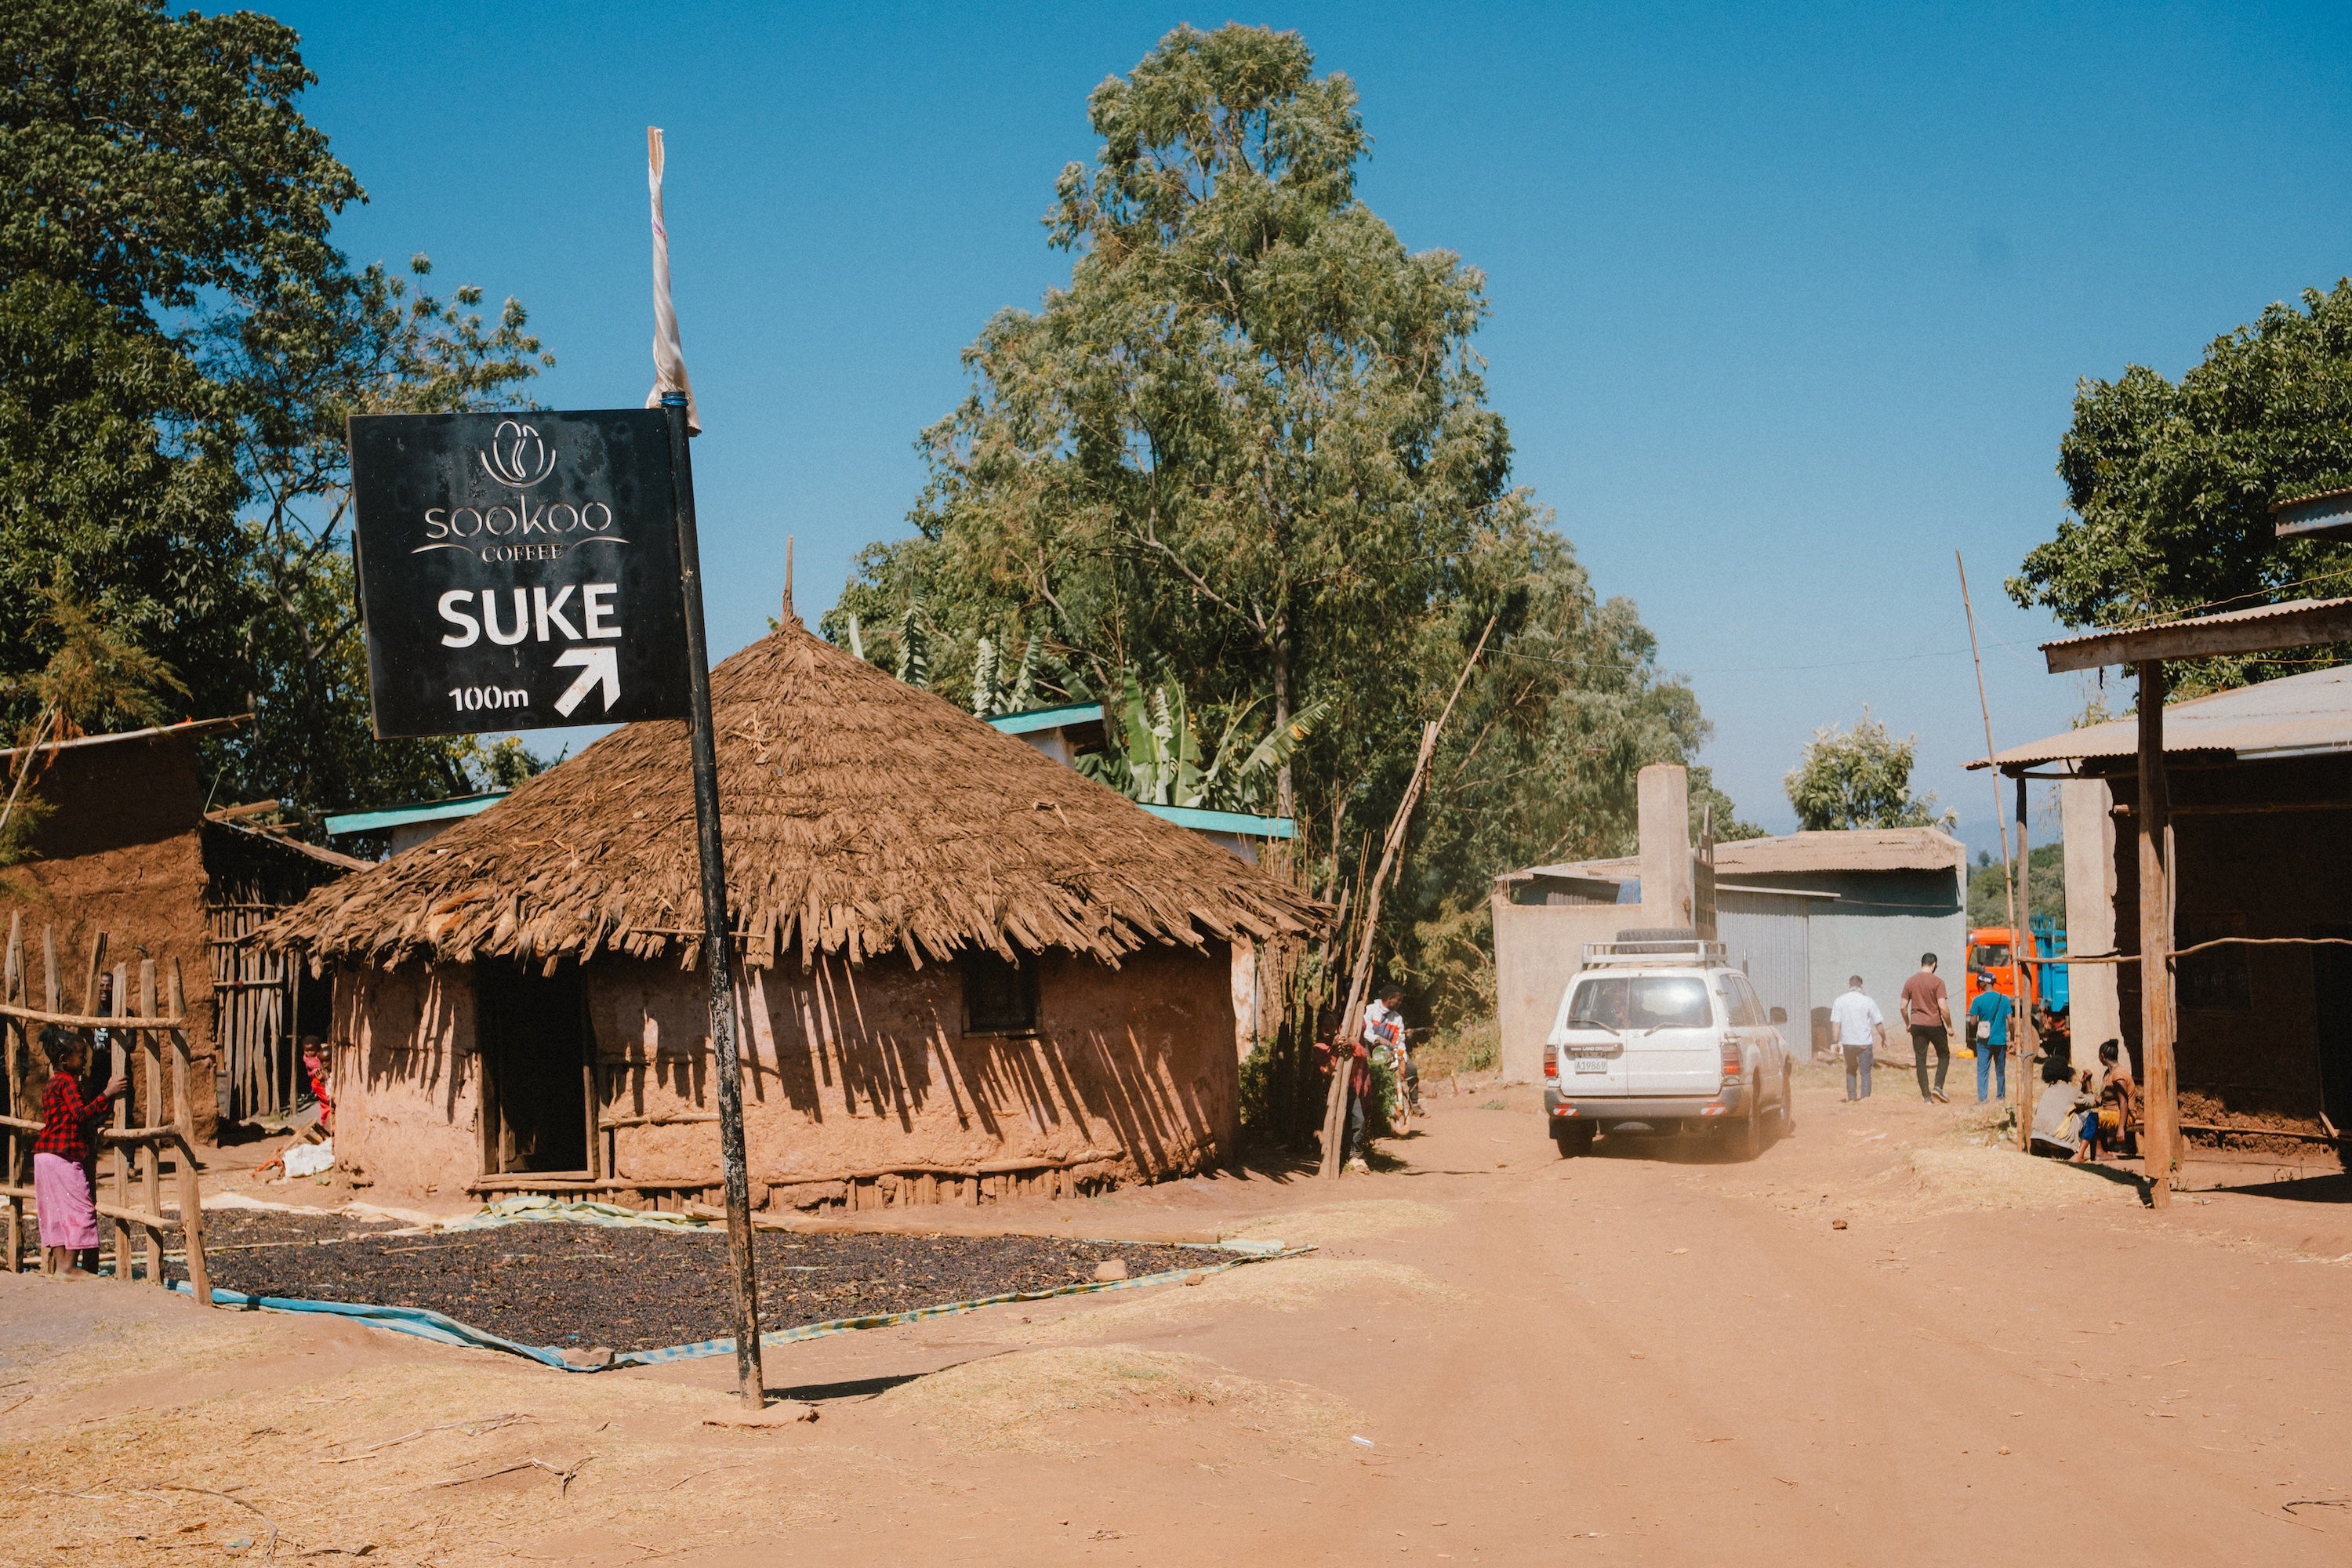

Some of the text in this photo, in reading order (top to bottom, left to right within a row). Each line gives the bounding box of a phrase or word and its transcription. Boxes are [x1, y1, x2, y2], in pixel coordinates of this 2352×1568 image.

[481, 543, 563, 563] COFFEE
[437, 583, 622, 648] SUKE
[448, 684, 529, 712] 100m
